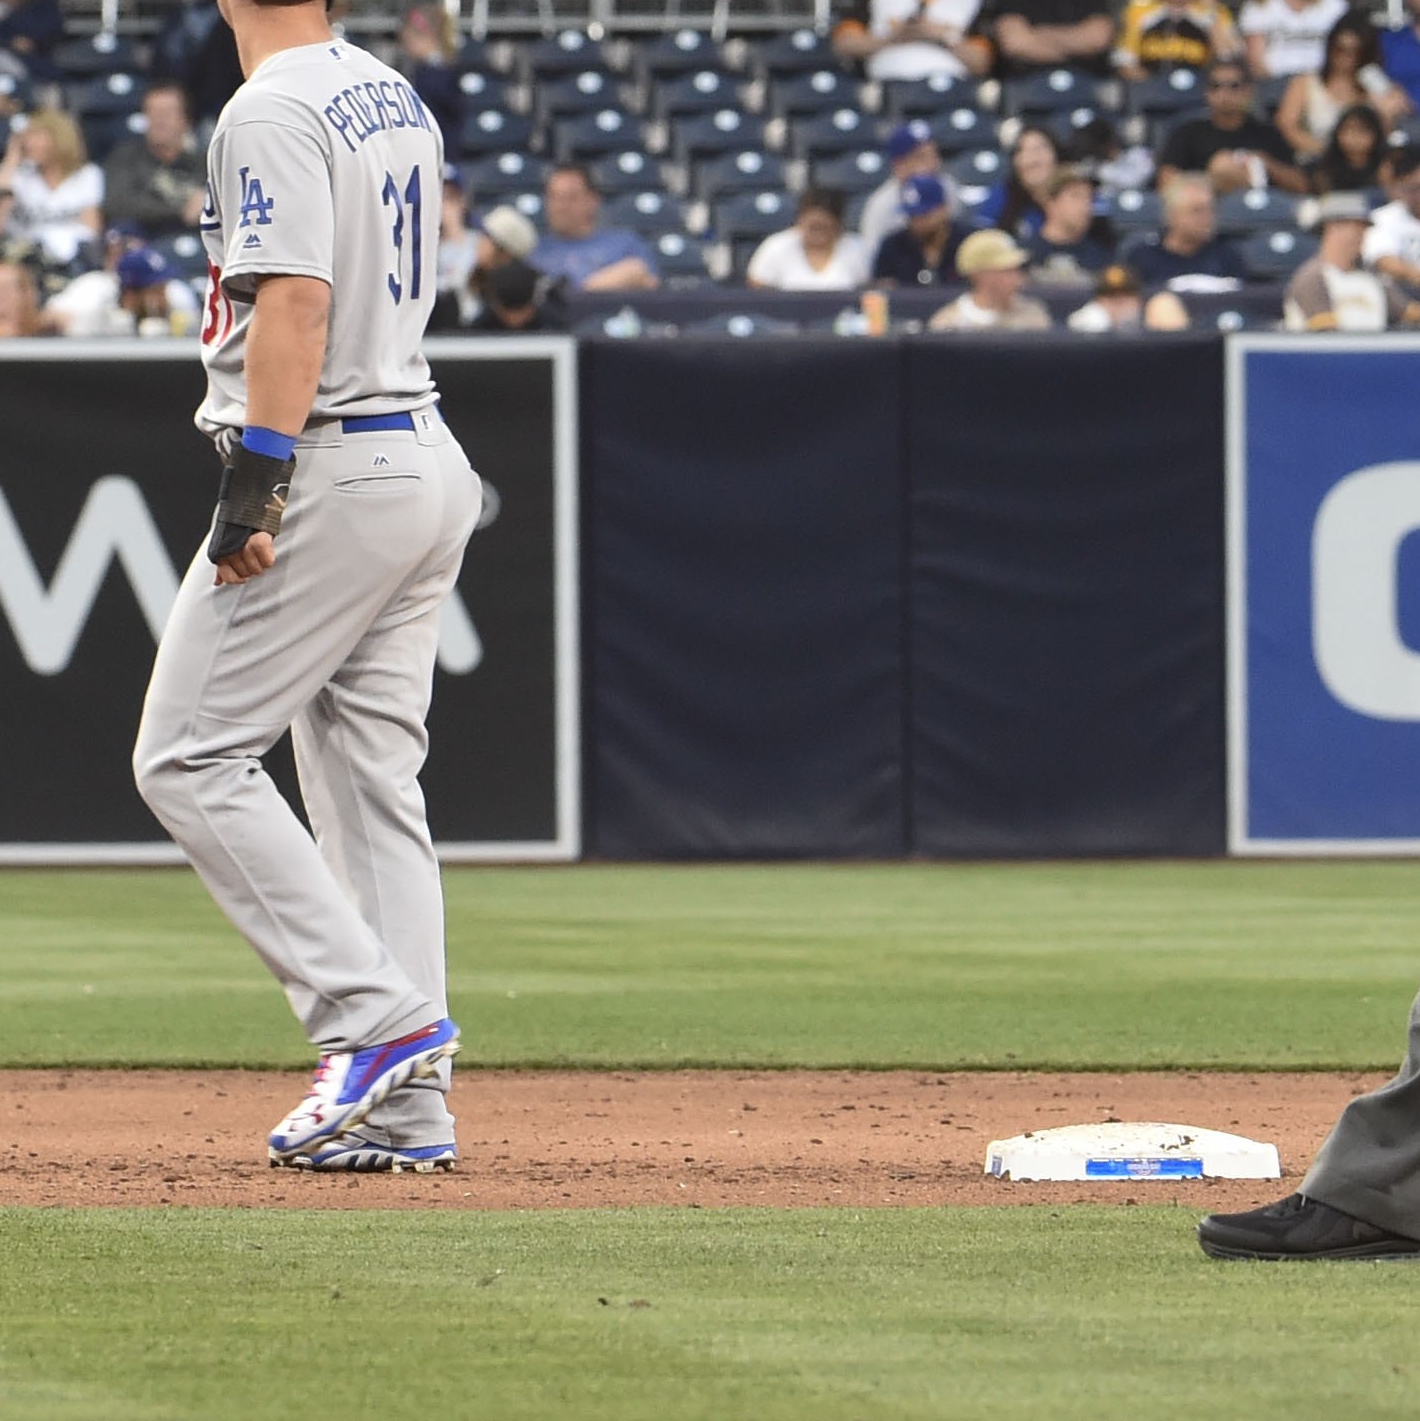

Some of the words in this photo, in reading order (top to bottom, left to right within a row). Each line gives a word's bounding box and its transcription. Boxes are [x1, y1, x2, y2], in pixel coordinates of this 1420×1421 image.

[323, 80, 433, 153] PEDERSON
[238, 166, 274, 227] LA
[382, 164, 421, 306] 31
